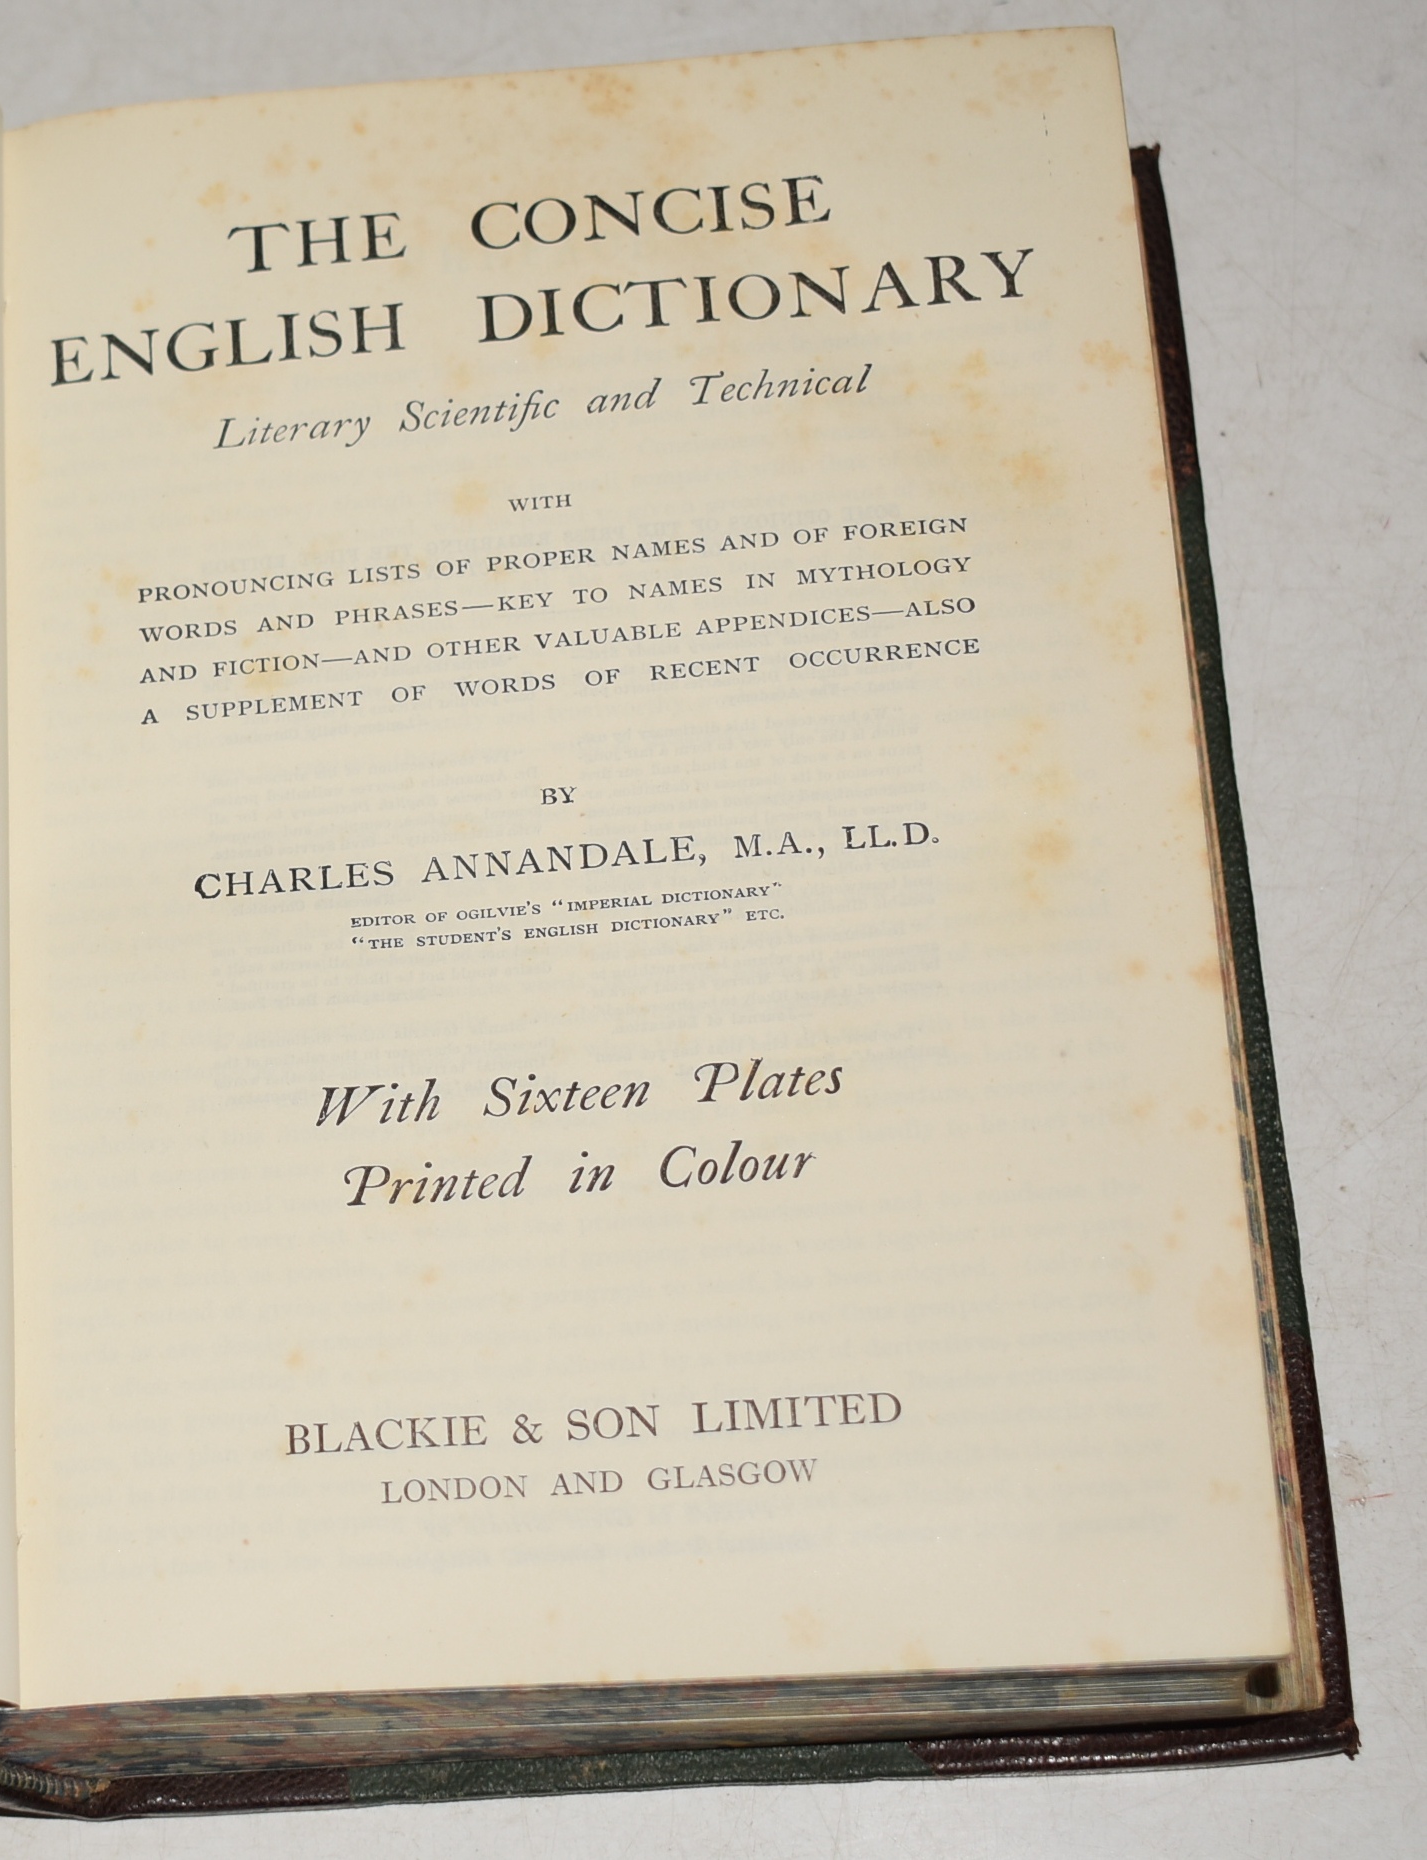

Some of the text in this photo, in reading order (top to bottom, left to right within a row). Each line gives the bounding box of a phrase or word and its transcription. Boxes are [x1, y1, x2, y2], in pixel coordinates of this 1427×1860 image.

[227, 174, 831, 273] THE CONCISE
[50, 247, 1034, 387] ENGLISH DICTIONARY
[213, 363, 873, 450] Literary Scientific and Technical
[508, 493, 572, 512] WITH
[137, 517, 967, 604] PRONOUNCING LISTS OF PROPER NAMES AND OF FOREIGN
[138, 619, 237, 643] WORDS
[256, 613, 314, 633] AND
[572, 587, 608, 605] TO
[628, 576, 723, 600] NAMES
[745, 572, 775, 590] IN
[796, 556, 972, 586] MYTHOLOGY
[139, 664, 197, 684] AND
[426, 636, 521, 659] OTHER
[533, 621, 682, 650] VALUABLE
[140, 638, 980, 726] A SUPPLEMENT OF WORDS OF RECENT OCCURRENCE
[541, 786, 576, 805] BY
[194, 860, 394, 900] CHARLES
[421, 835, 707, 883] ANNANDALE,
[733, 831, 825, 860] M.A.,
[350, 913, 417, 929] EDITOR
[425, 911, 448, 923] OF
[455, 900, 541, 921] OGILVIE'S
[416, 926, 512, 947] STUDENT'S
[523, 922, 599, 940] ENGLISH
[745, 908, 785, 922] ETC.
[315, 1057, 843, 1127] With Sixteen Plates
[343, 1139, 817, 1207] Printed in Colour
[284, 1392, 902, 1456] BLACKIE & SON LIMITED
[380, 1458, 818, 1504] LONDON AND GLASGOW
